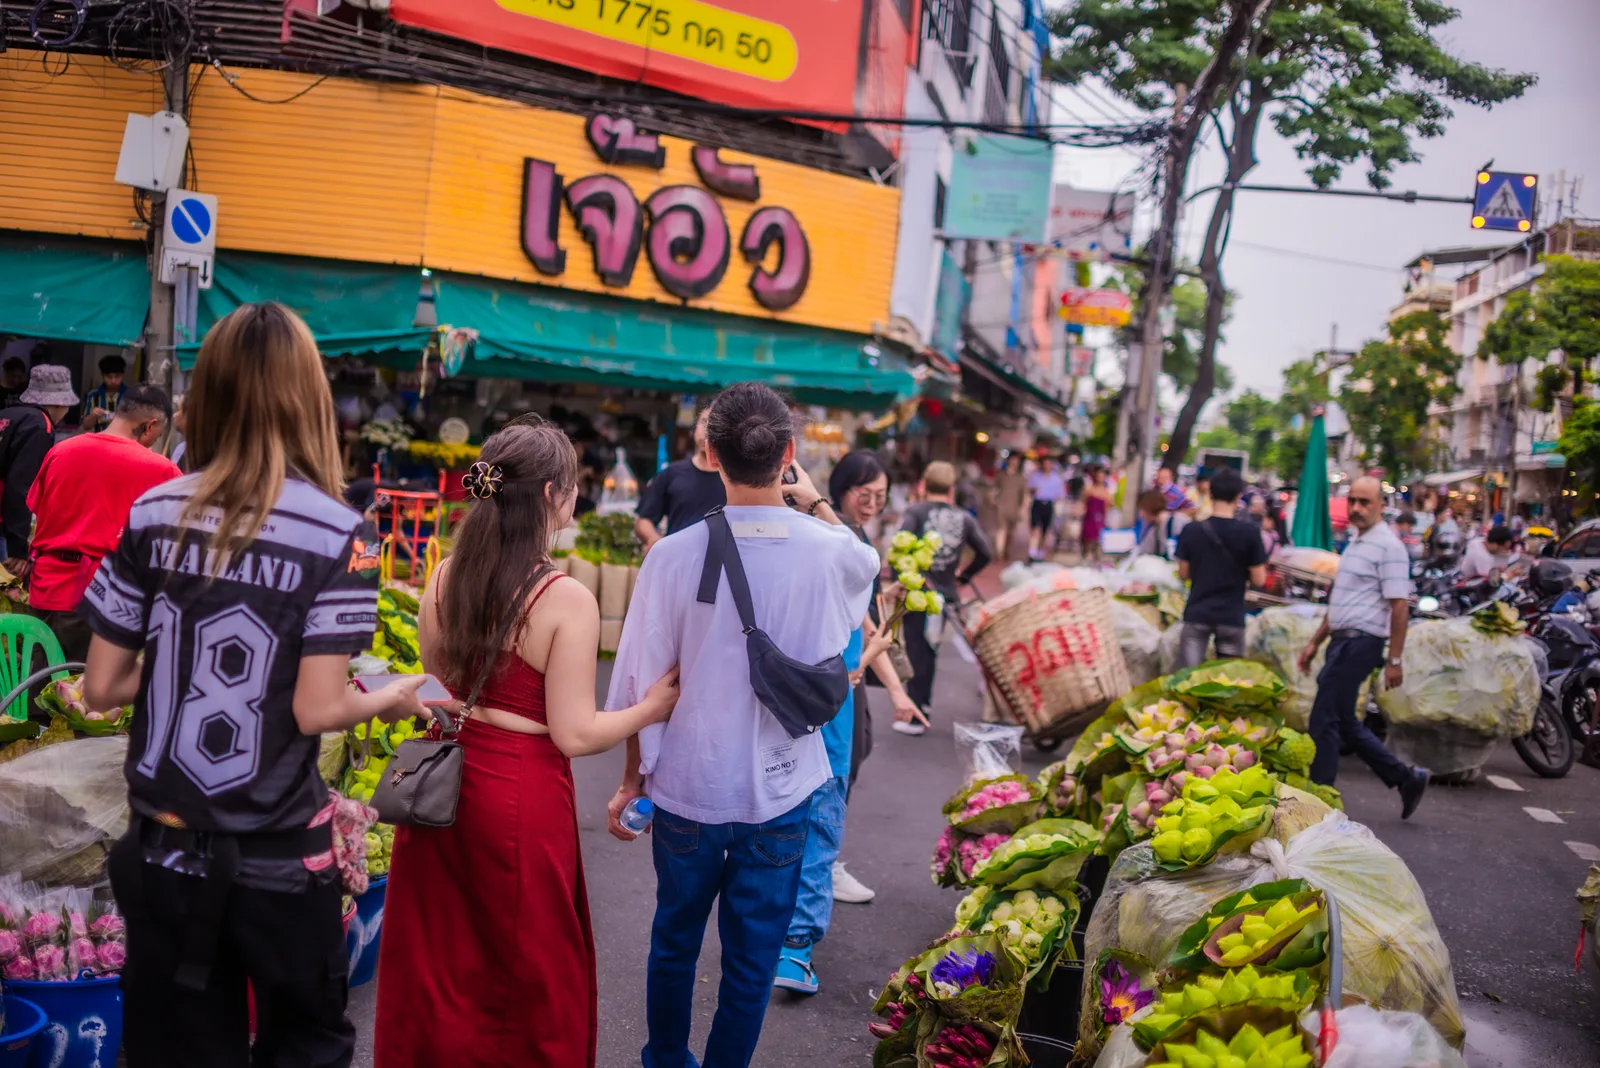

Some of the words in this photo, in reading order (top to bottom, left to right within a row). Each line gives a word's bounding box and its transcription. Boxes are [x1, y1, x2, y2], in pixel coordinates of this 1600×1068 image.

[597, 0, 671, 36] 1775
[684, 21, 724, 52] กด
[736, 32, 773, 64] 50
[136, 591, 279, 797] 18
[765, 764, 781, 773] KIMO
[781, 761, 791, 769] NO
